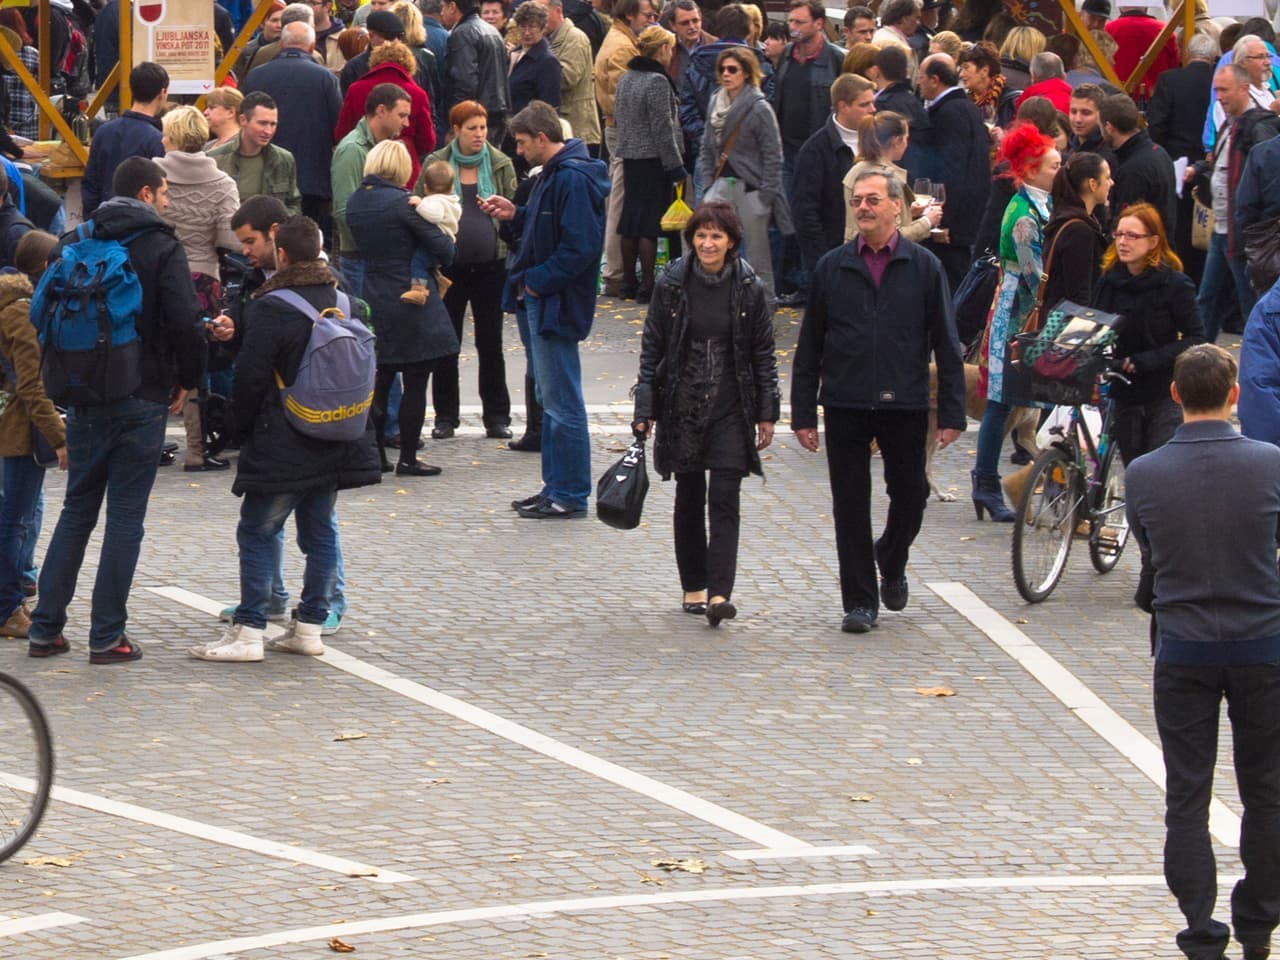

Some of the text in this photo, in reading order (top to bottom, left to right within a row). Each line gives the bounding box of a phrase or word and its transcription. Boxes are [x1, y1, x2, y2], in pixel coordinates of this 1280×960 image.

[155, 31, 209, 41] LJUBLJANSKA
[155, 41, 209, 50] VINSKA POT 2011
